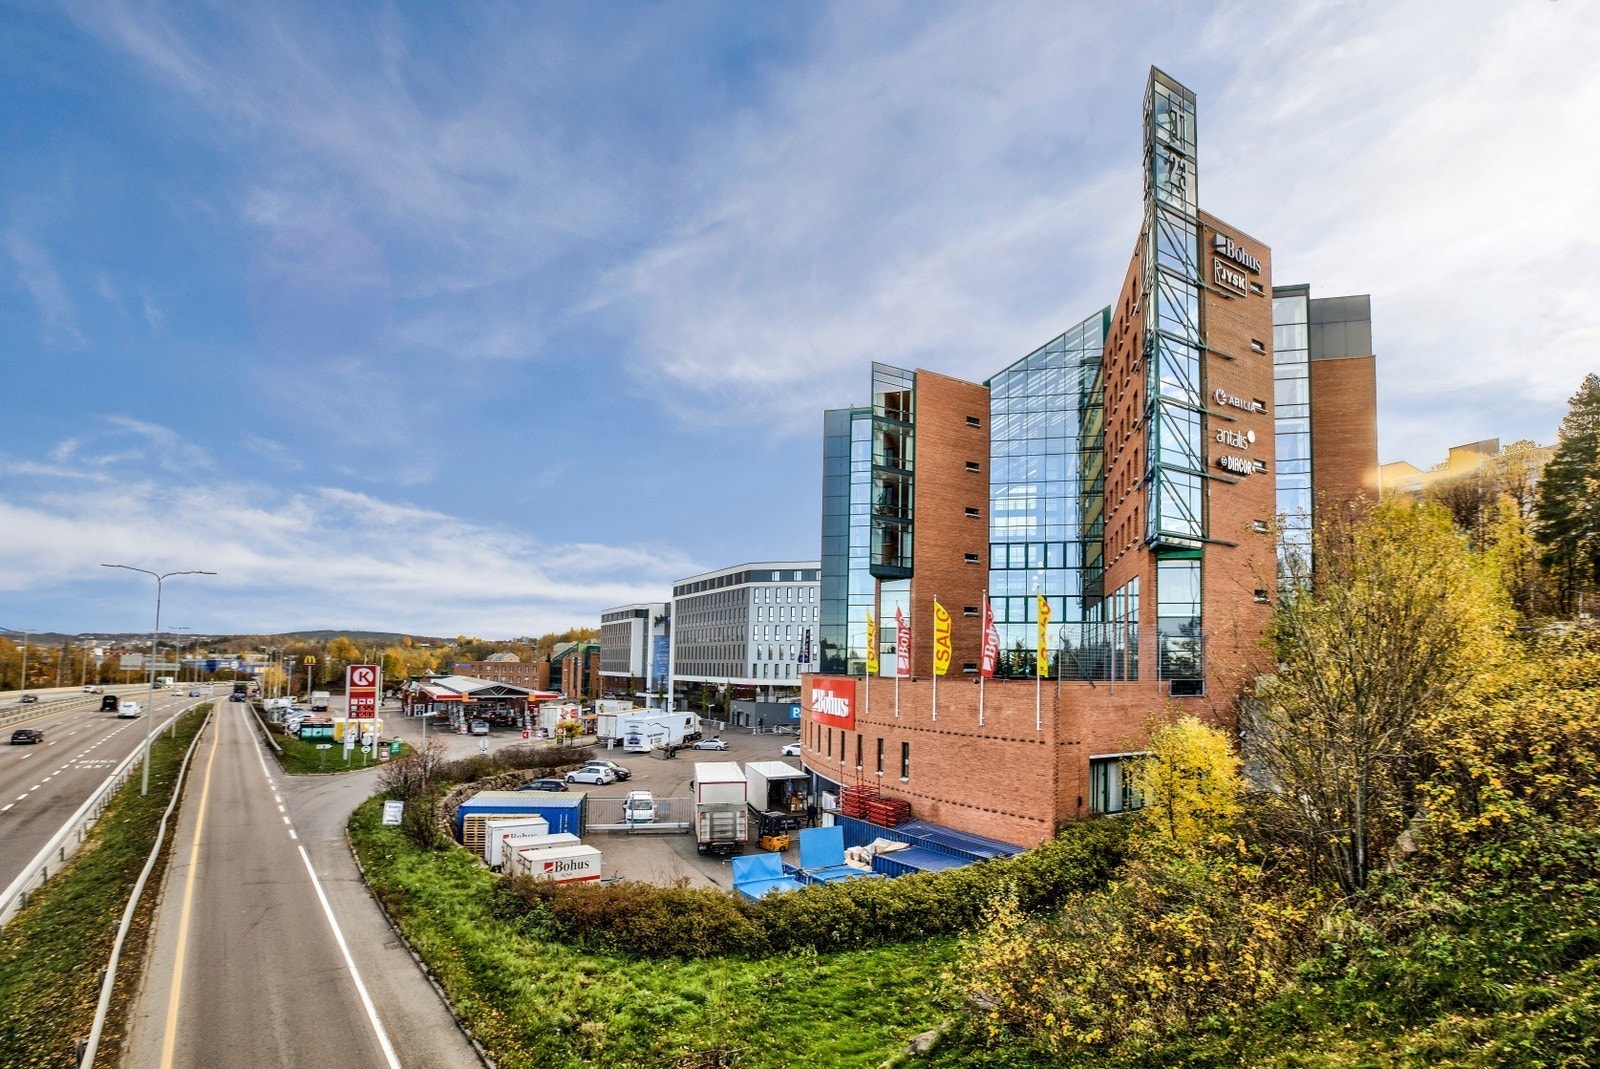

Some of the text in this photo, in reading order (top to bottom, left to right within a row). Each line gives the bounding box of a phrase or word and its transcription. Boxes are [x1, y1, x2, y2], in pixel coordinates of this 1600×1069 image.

[1227, 239, 1262, 273] Bohus
[1221, 268, 1246, 290] JYSK
[1228, 396, 1256, 413] ABILIA
[1216, 428, 1249, 450] antalis
[1227, 455, 1253, 475] DIACOR
[817, 690, 849, 718] Bohus
[555, 860, 590, 873] Bohus
